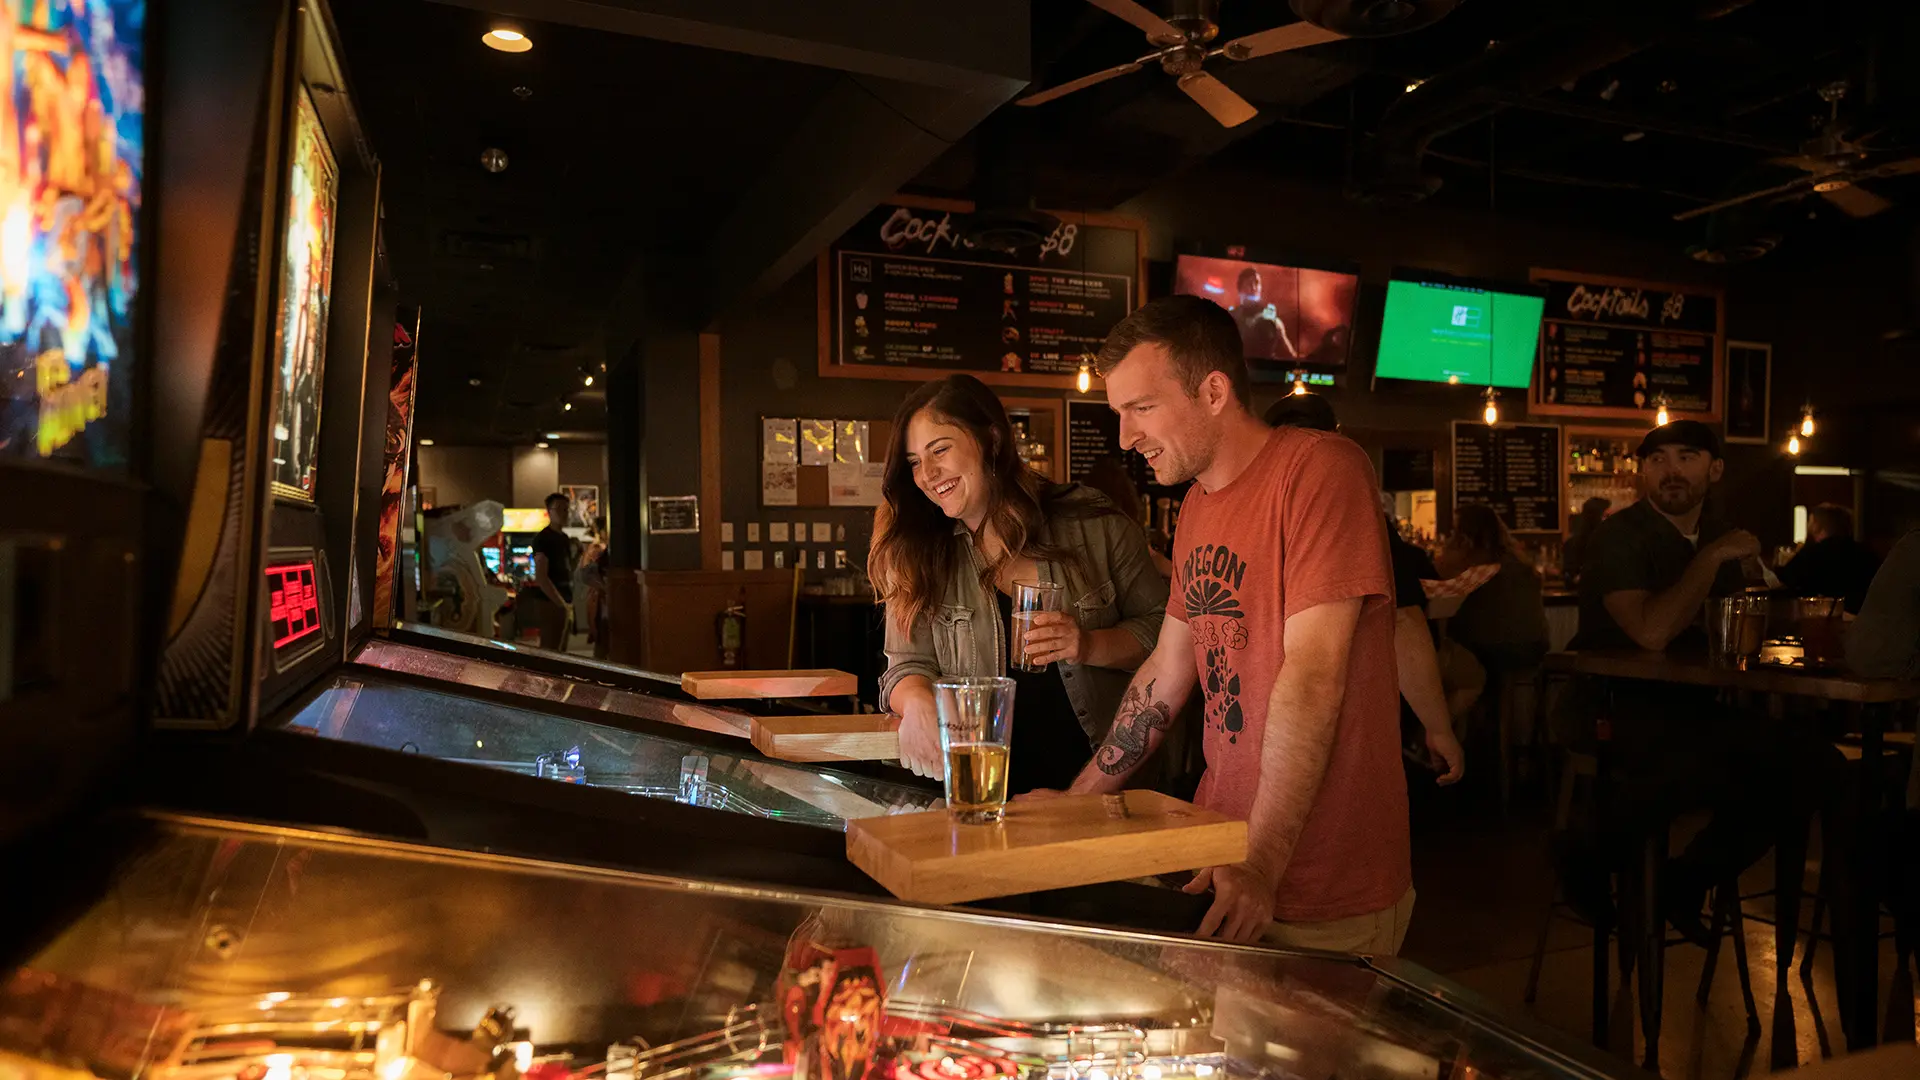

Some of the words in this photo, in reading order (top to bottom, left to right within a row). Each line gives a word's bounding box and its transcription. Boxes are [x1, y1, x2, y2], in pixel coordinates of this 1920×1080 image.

[1038, 222, 1078, 261] $8
[1659, 291, 1685, 324] $8
[1182, 544, 1247, 593] OREGON
